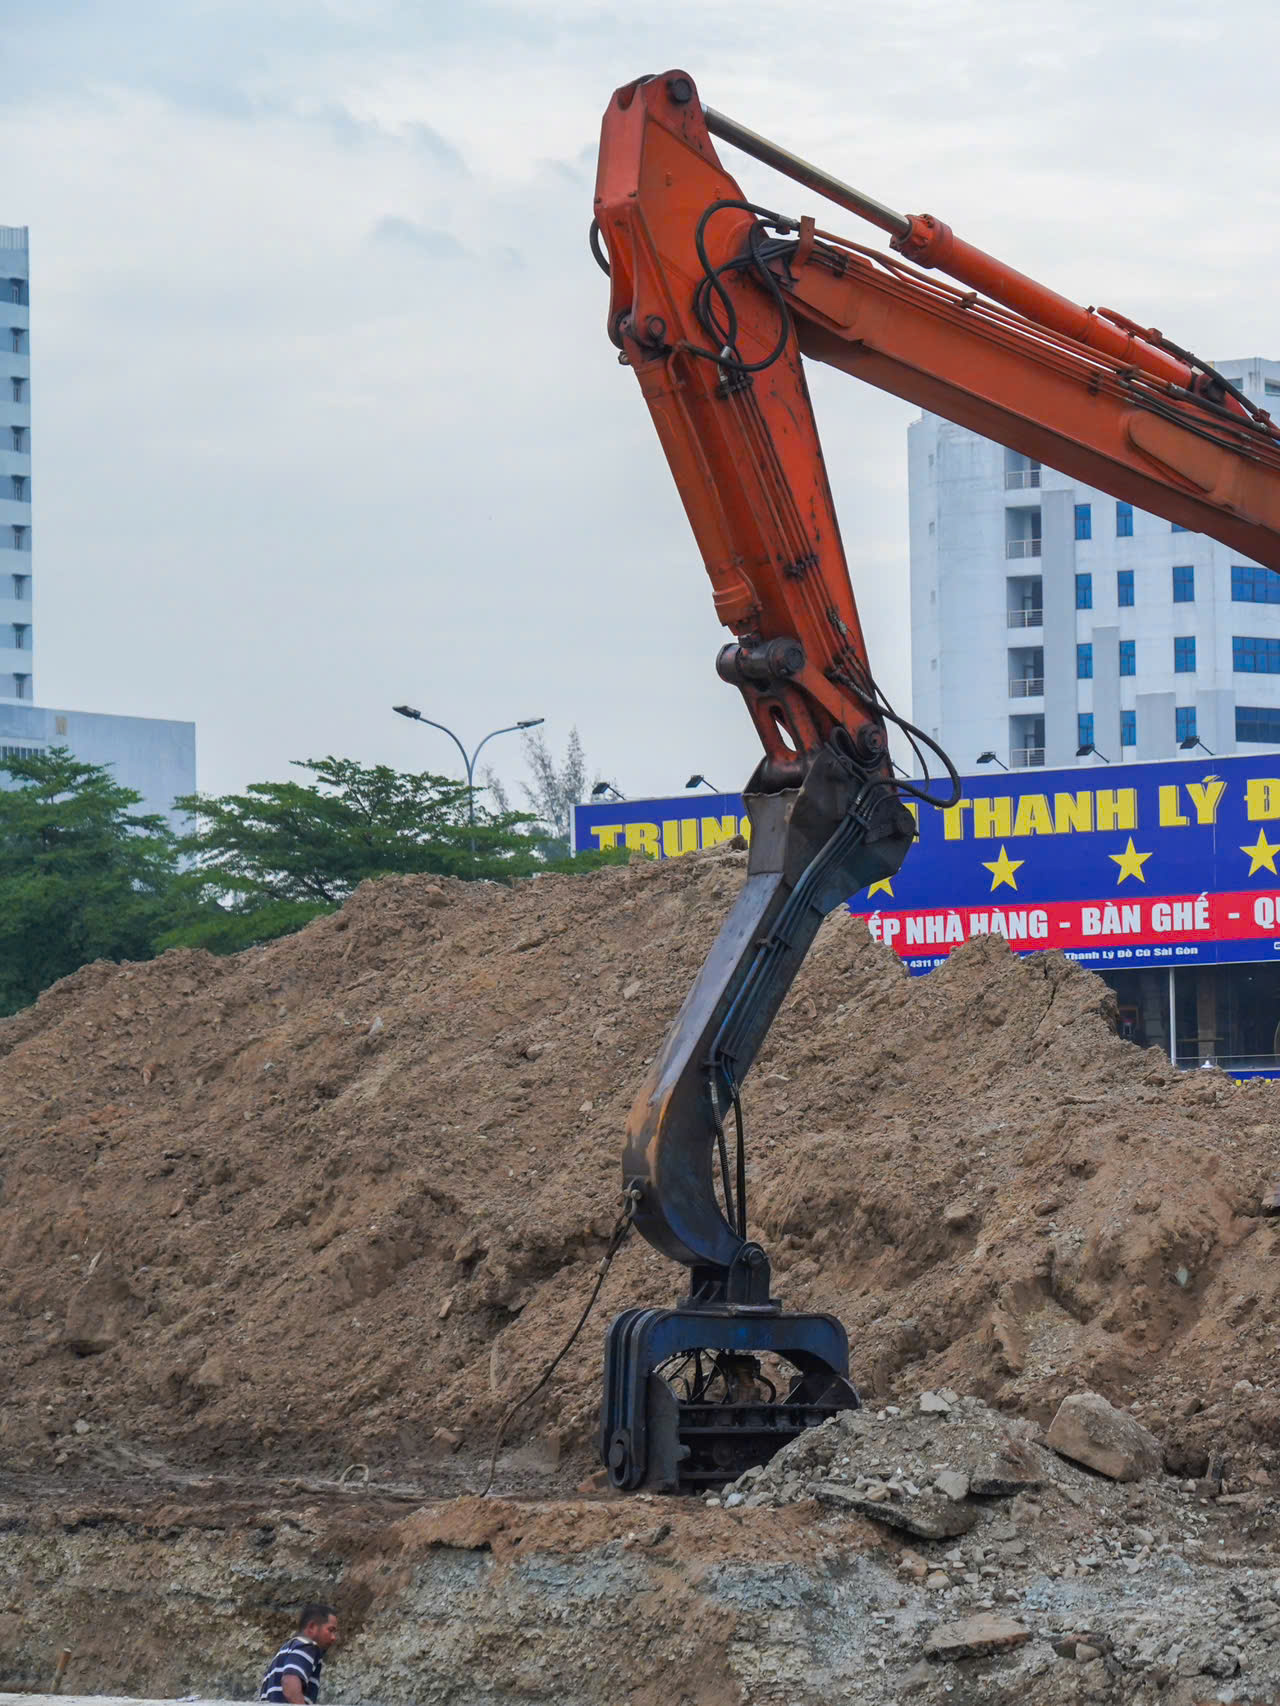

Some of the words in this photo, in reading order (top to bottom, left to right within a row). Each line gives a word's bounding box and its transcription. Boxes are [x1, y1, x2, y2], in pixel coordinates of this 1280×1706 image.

[935, 787, 1138, 841] THANH
[1158, 775, 1228, 827] LÝ
[867, 910, 901, 946] ẾP
[905, 910, 965, 945] NHÀ
[969, 907, 1049, 940] HÀNG
[1081, 901, 1142, 936] BÀN
[1151, 892, 1210, 932] GHẾ
[909, 959, 932, 968] 4311
[1064, 951, 1100, 961] Thanh
[1175, 946, 1199, 956] Gòn
